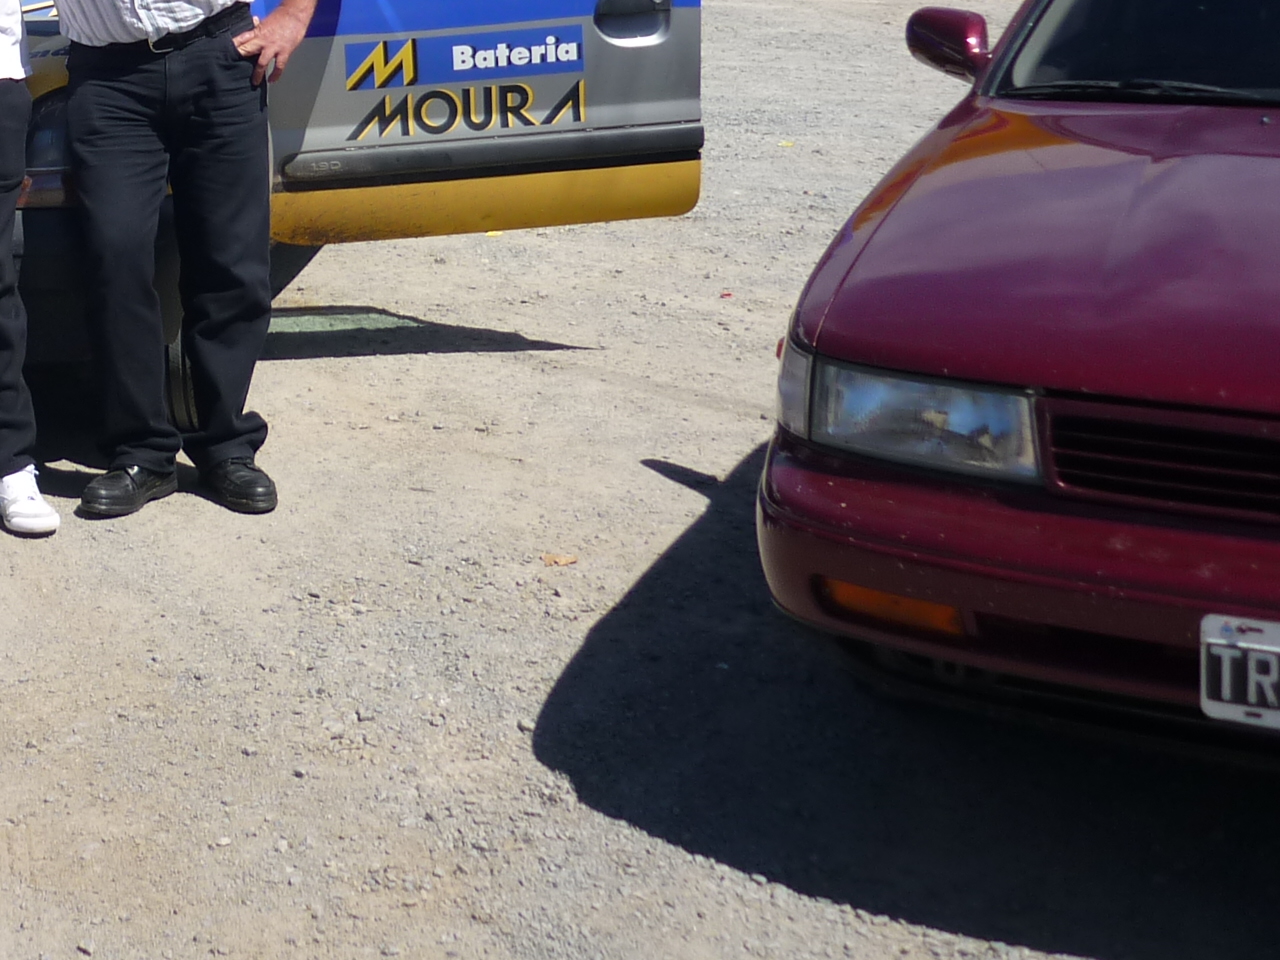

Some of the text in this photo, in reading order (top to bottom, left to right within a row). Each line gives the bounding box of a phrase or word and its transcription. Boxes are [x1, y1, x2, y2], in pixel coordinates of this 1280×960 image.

[452, 35, 579, 71] Bateria
[345, 79, 587, 141] MOURA
[1209, 644, 1278, 707] TR
